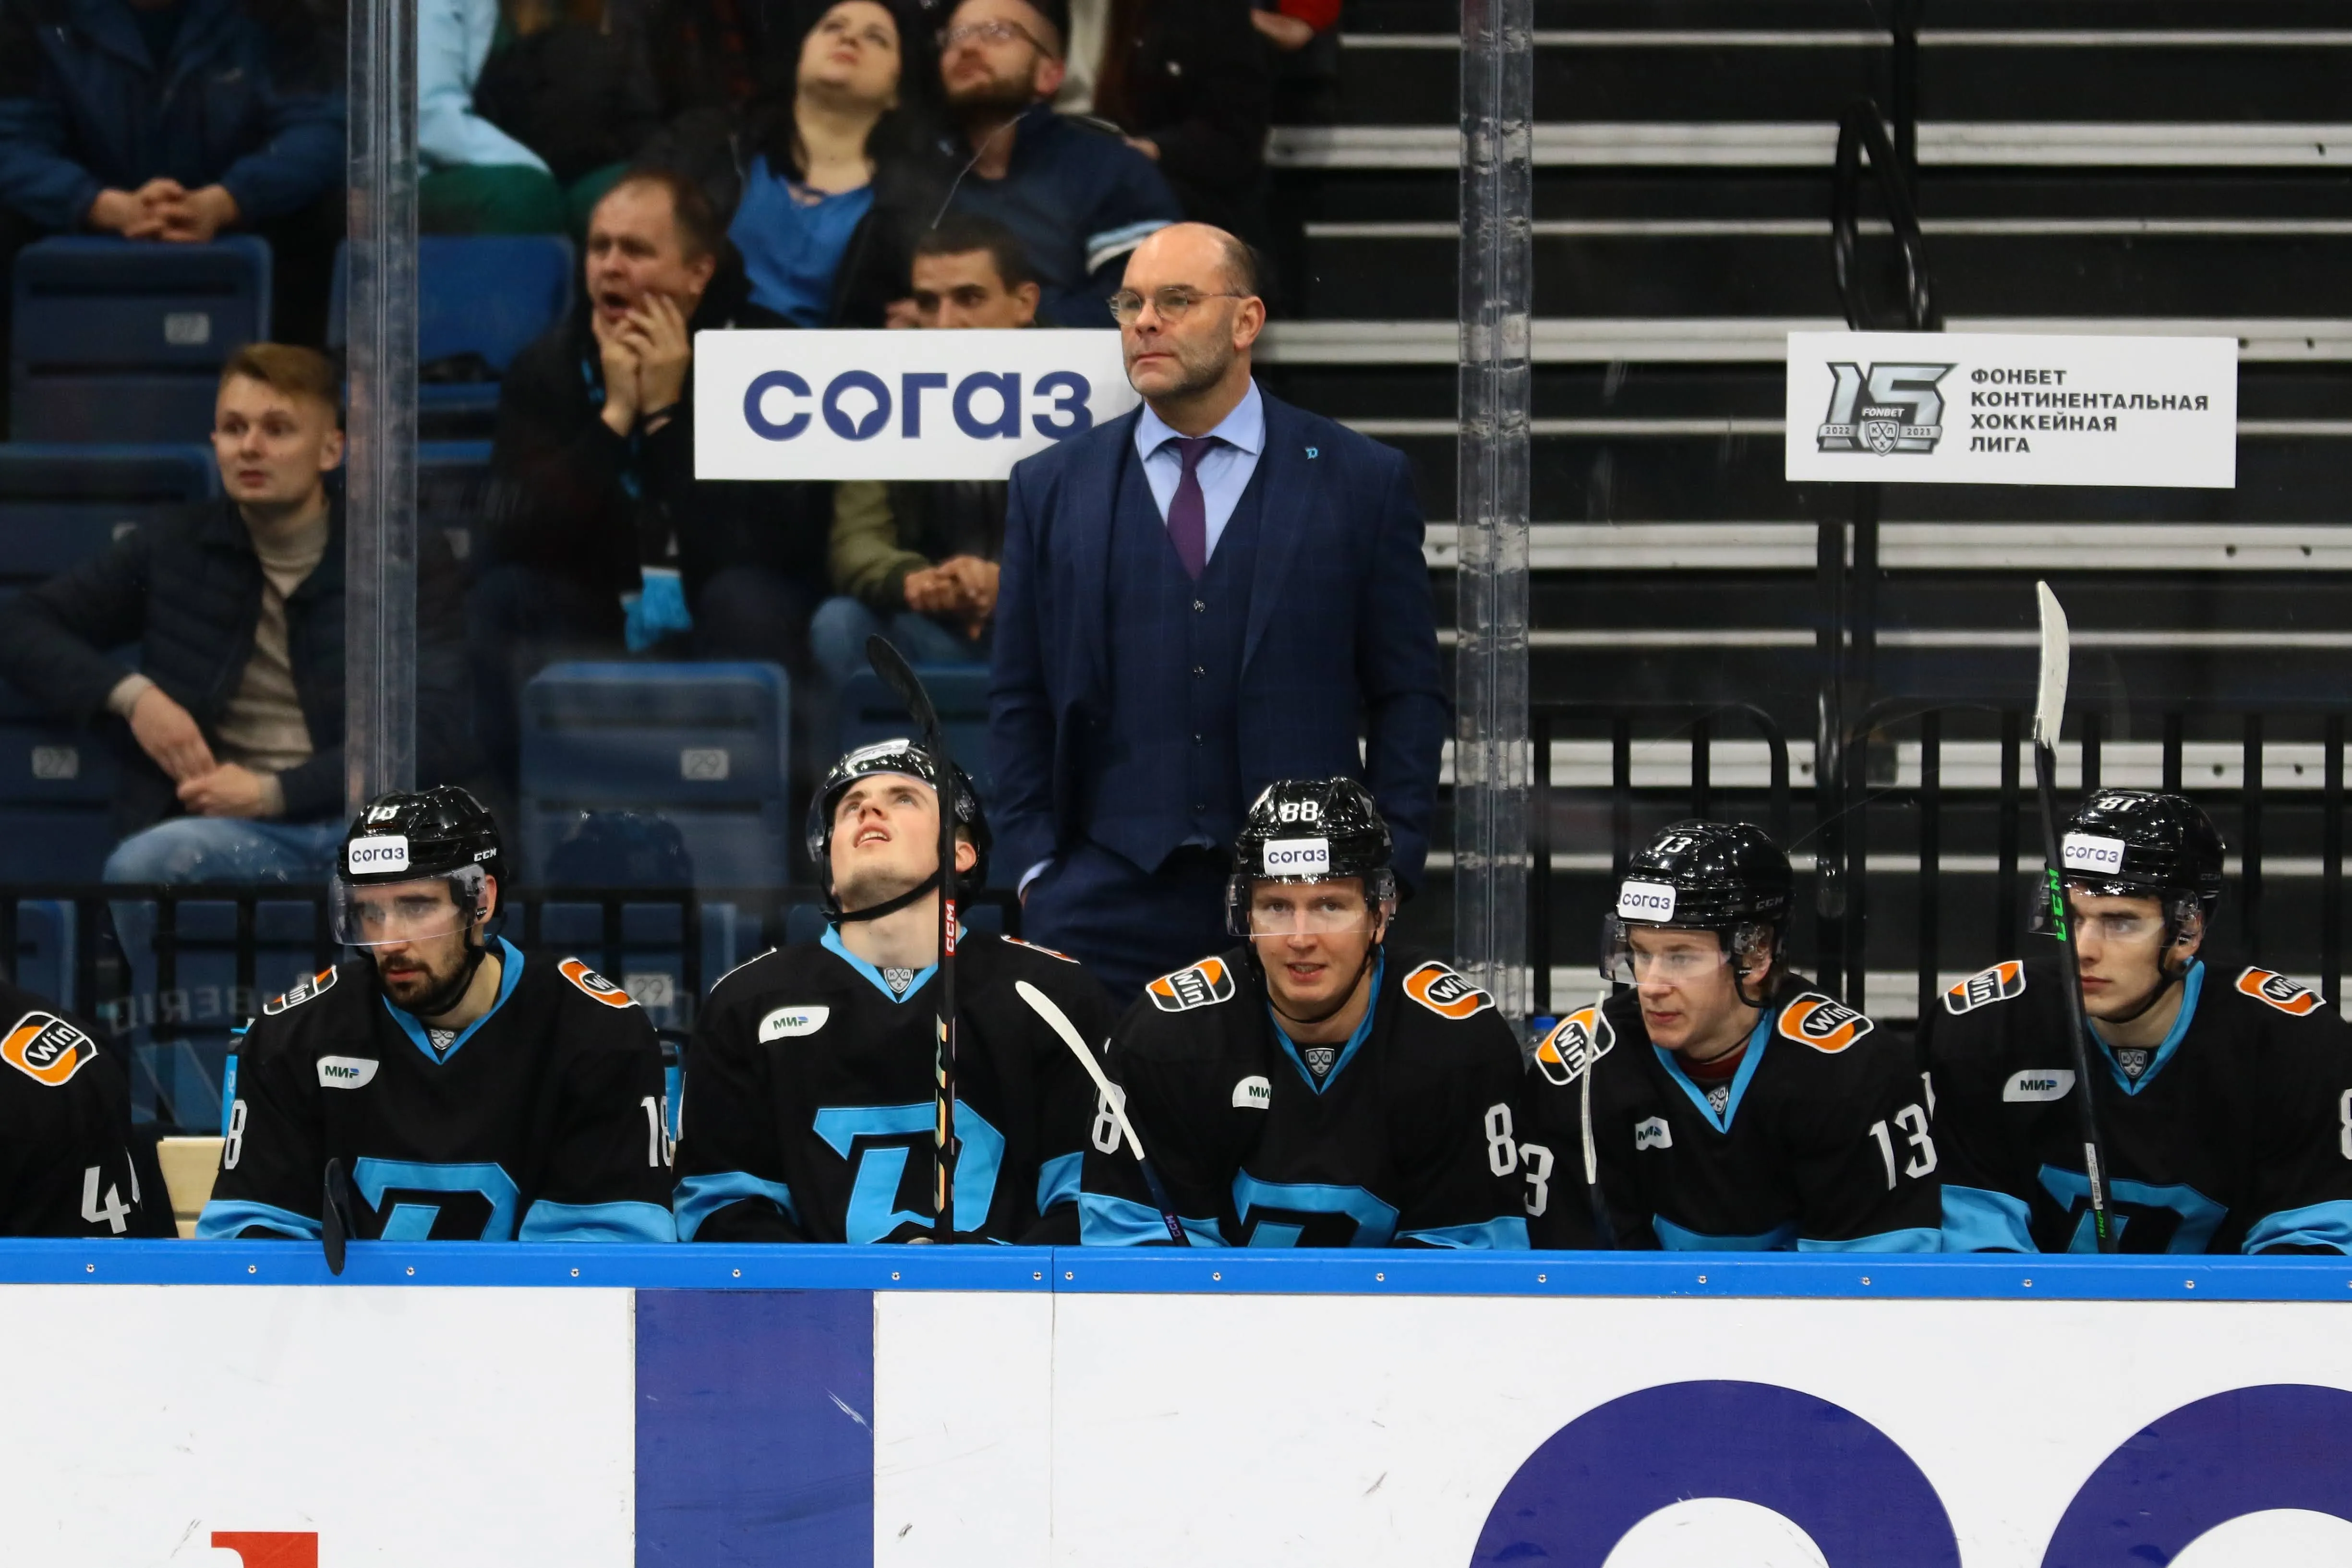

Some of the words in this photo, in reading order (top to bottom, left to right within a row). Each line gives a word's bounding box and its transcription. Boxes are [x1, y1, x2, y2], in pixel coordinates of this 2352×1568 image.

[1970, 369, 2067, 386] ФОНБЕТ
[744, 369, 1093, 442] согаз
[1971, 392, 2208, 411] КОНТИНЕНТАЛЬНАЯ
[1861, 408, 1905, 417] FONBET
[1826, 426, 1850, 434] 2022
[1970, 411, 2118, 432] ХОККЕЙНАЯ
[1969, 436, 2030, 453] ЛИГА
[1280, 800, 1318, 822] 88
[2097, 796, 2136, 811] 81
[1656, 836, 1693, 853] 13
[474, 847, 497, 862] CCM
[946, 904, 956, 953] CCM
[772, 1015, 809, 1030] МИР
[325, 1065, 360, 1079] МИР
[1249, 1086, 1270, 1099] МИ
[2020, 1079, 2057, 1091] МИР
[1869, 1103, 1938, 1191] 13
[1165, 1214, 1181, 1238] CCM
